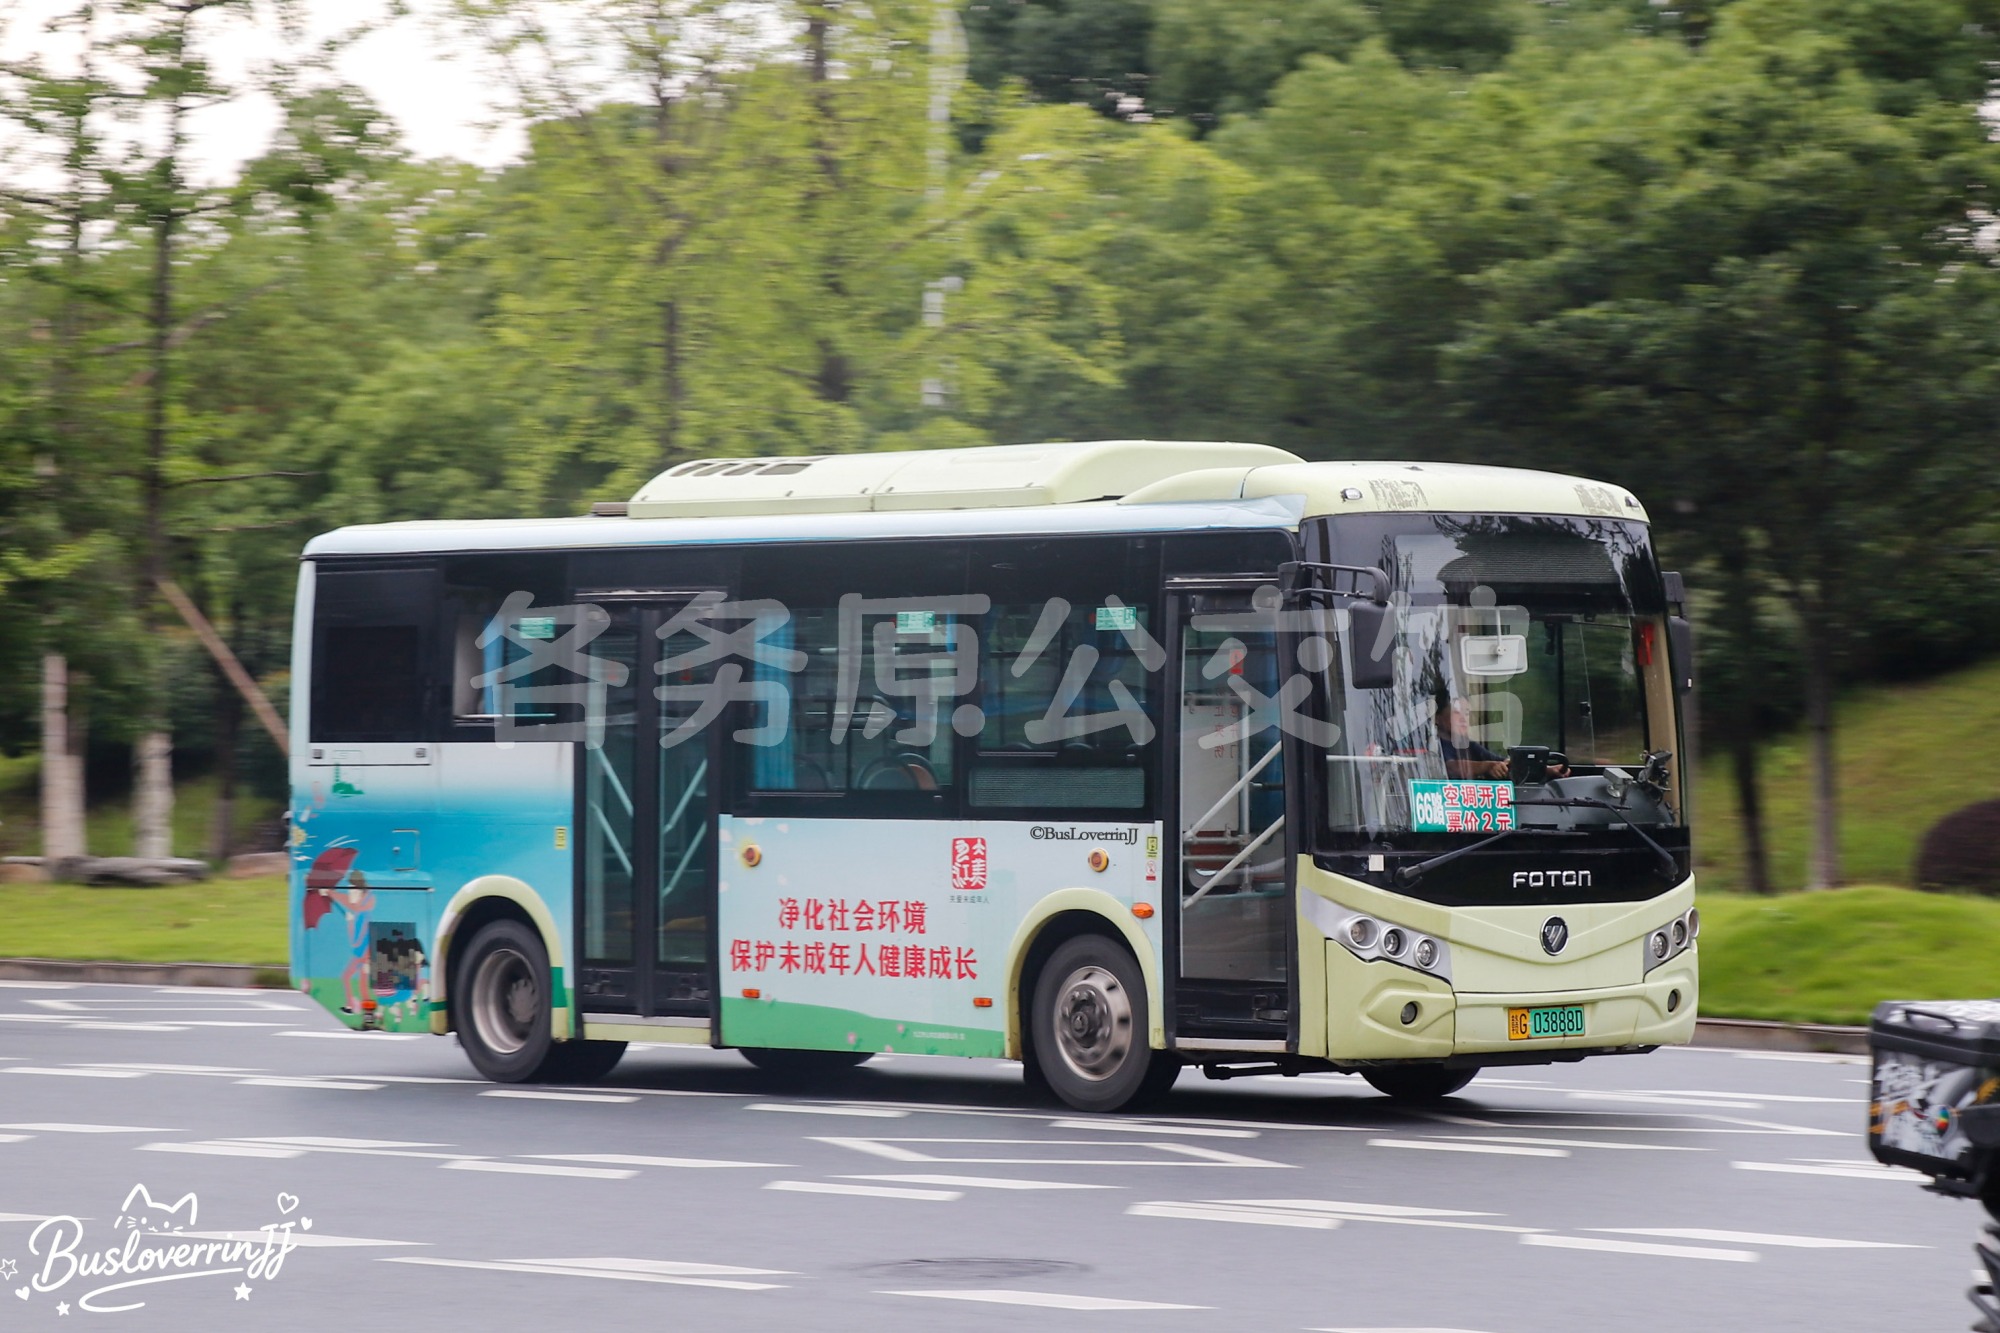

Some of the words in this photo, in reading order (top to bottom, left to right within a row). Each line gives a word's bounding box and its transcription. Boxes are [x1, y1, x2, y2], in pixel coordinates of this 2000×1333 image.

[1416, 791, 1445, 825] 66路
[1443, 784, 1512, 809] 空调开启
[1446, 810, 1513, 832] 票价2元
[1513, 871, 1591, 888] FOTON
[779, 898, 926, 934] 净化社会环境
[730, 939, 978, 980] 保护未成年人健康成长
